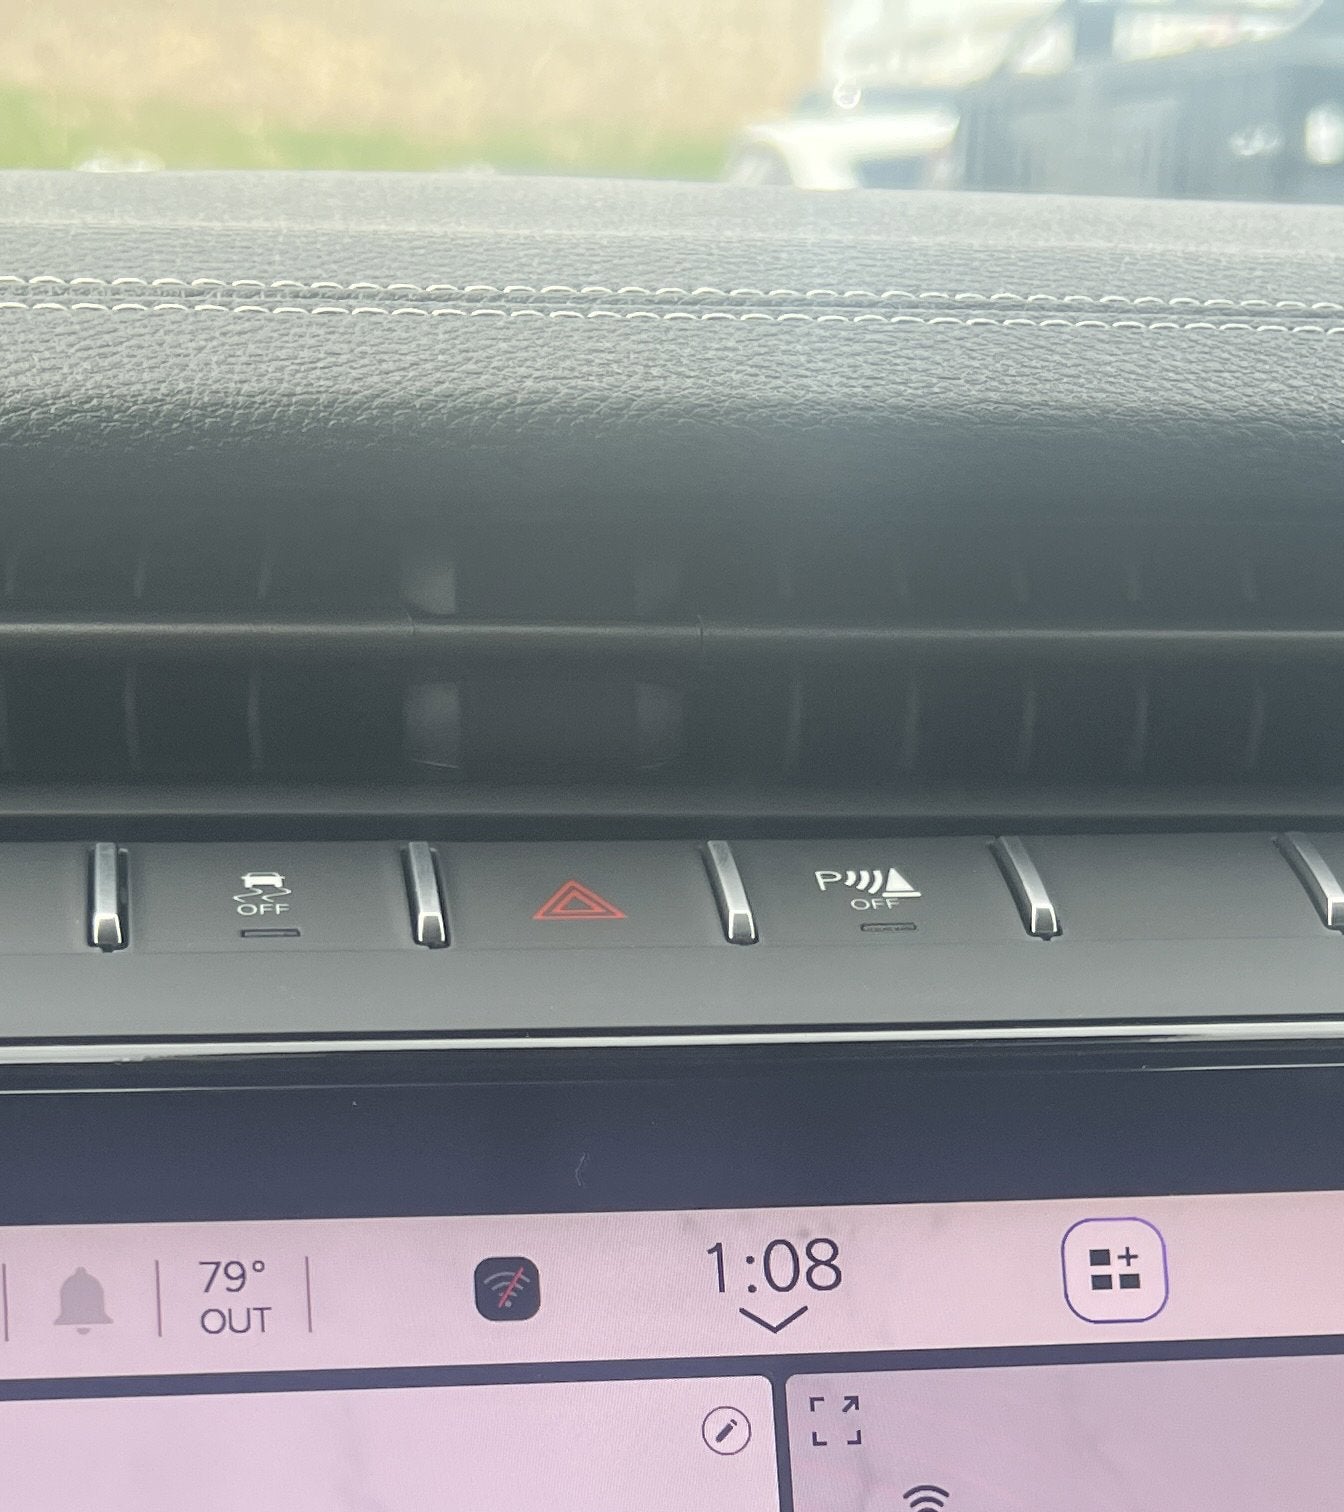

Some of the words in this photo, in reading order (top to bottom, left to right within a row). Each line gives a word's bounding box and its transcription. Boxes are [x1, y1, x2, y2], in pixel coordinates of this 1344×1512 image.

[236, 903, 291, 915] OFF
[851, 898, 899, 910] OFF
[199, 1260, 266, 1293] 79°
[705, 1237, 843, 1294] 1:08
[200, 1306, 272, 1334] OUT
